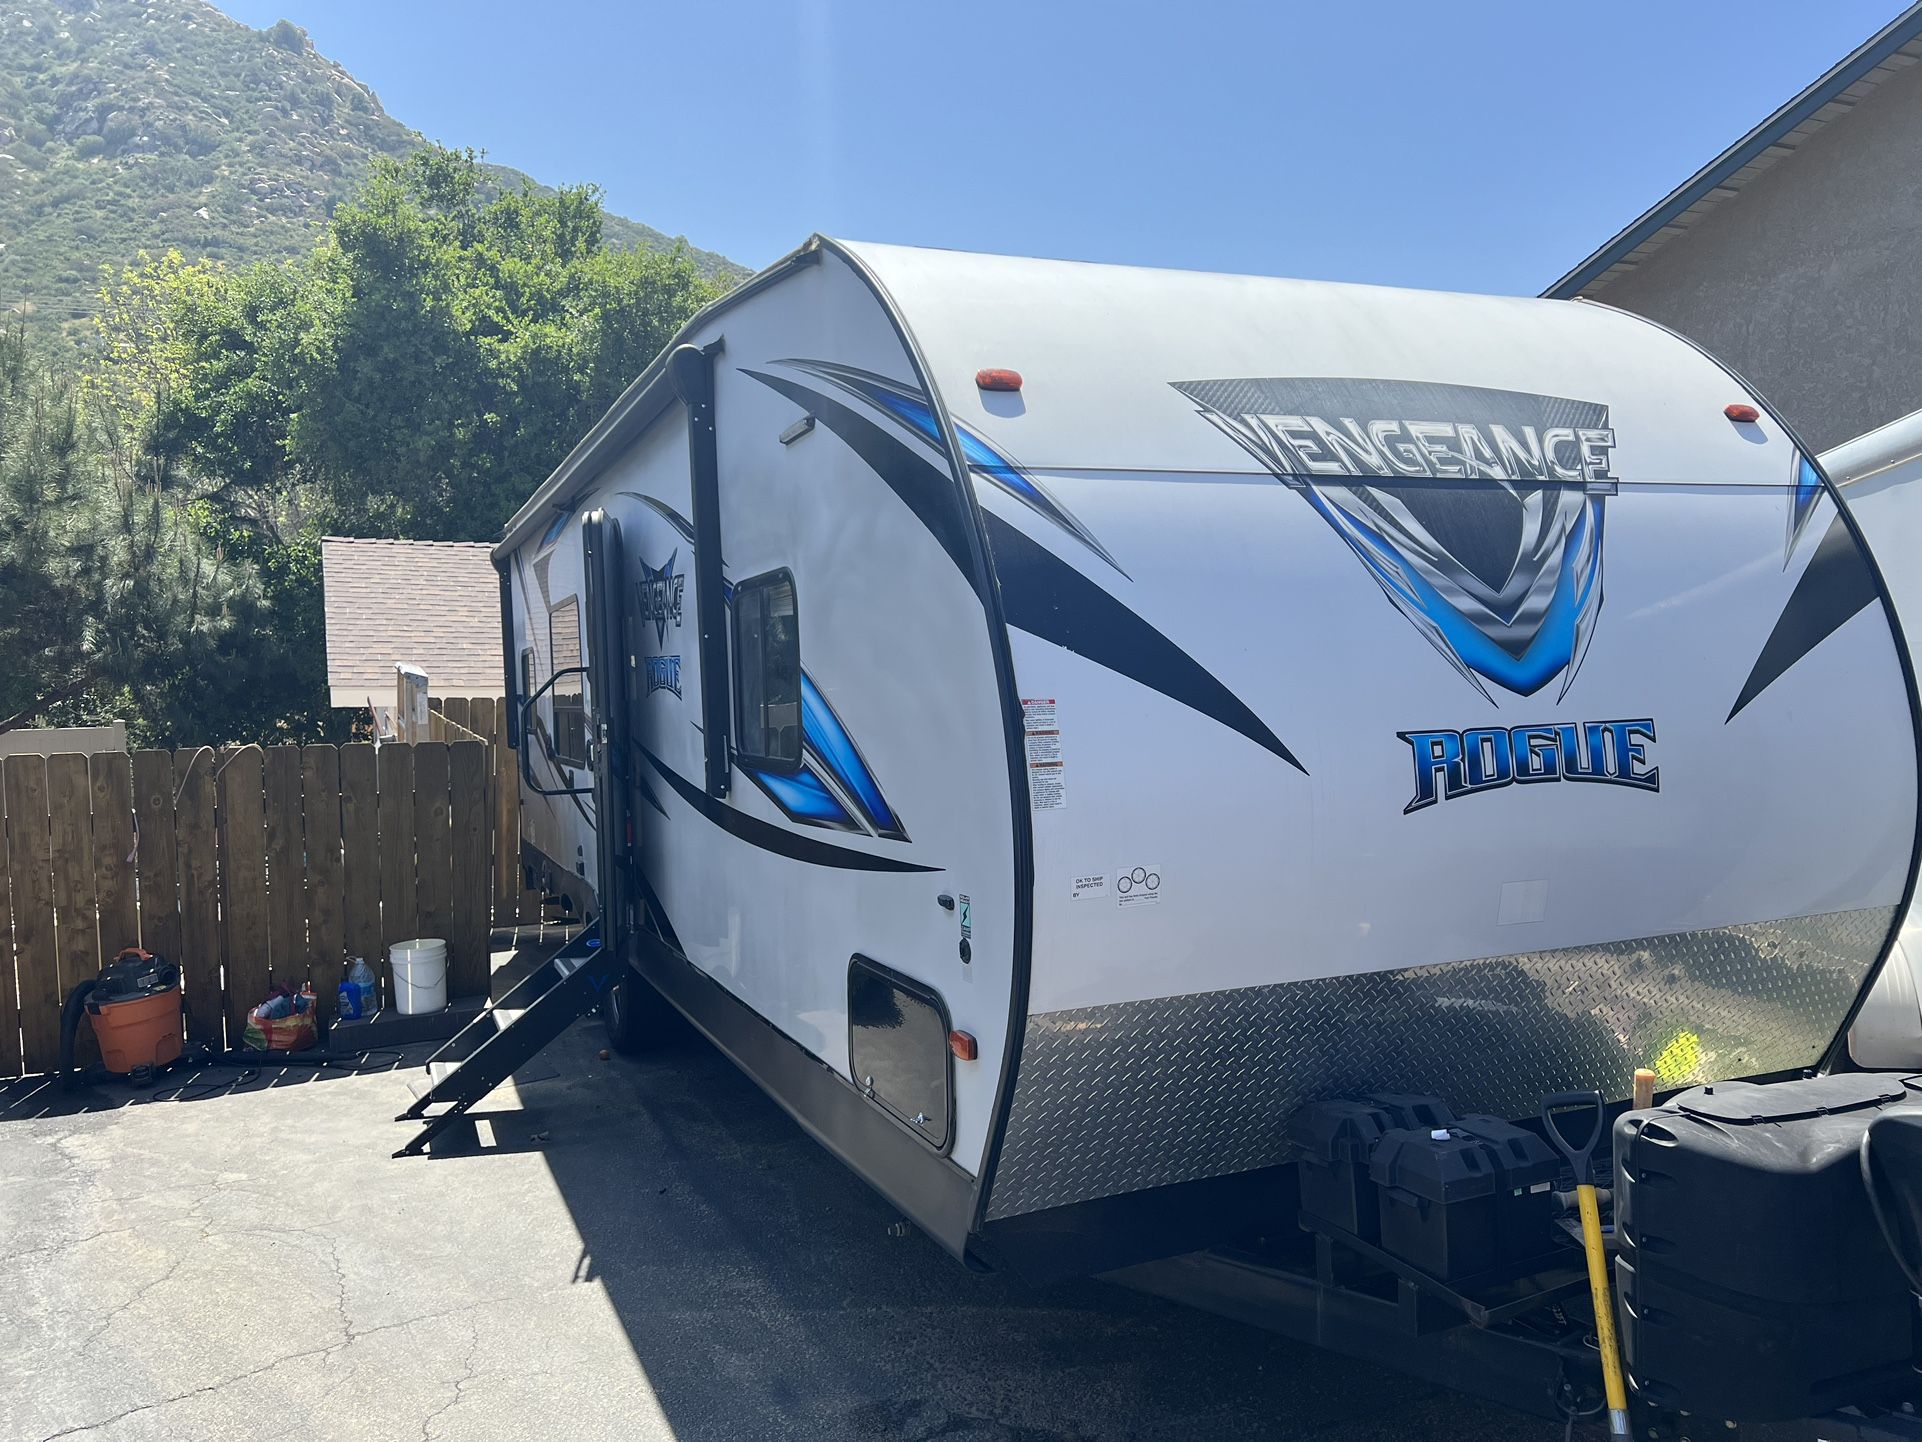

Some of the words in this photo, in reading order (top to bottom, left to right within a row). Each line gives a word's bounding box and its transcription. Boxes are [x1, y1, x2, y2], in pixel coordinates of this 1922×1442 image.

[1195, 410, 1619, 496] VENGEANCE
[644, 655, 683, 701] ROGUE
[1396, 717, 1660, 815] ROGUE
[1075, 882, 1104, 890] INSPECTED
